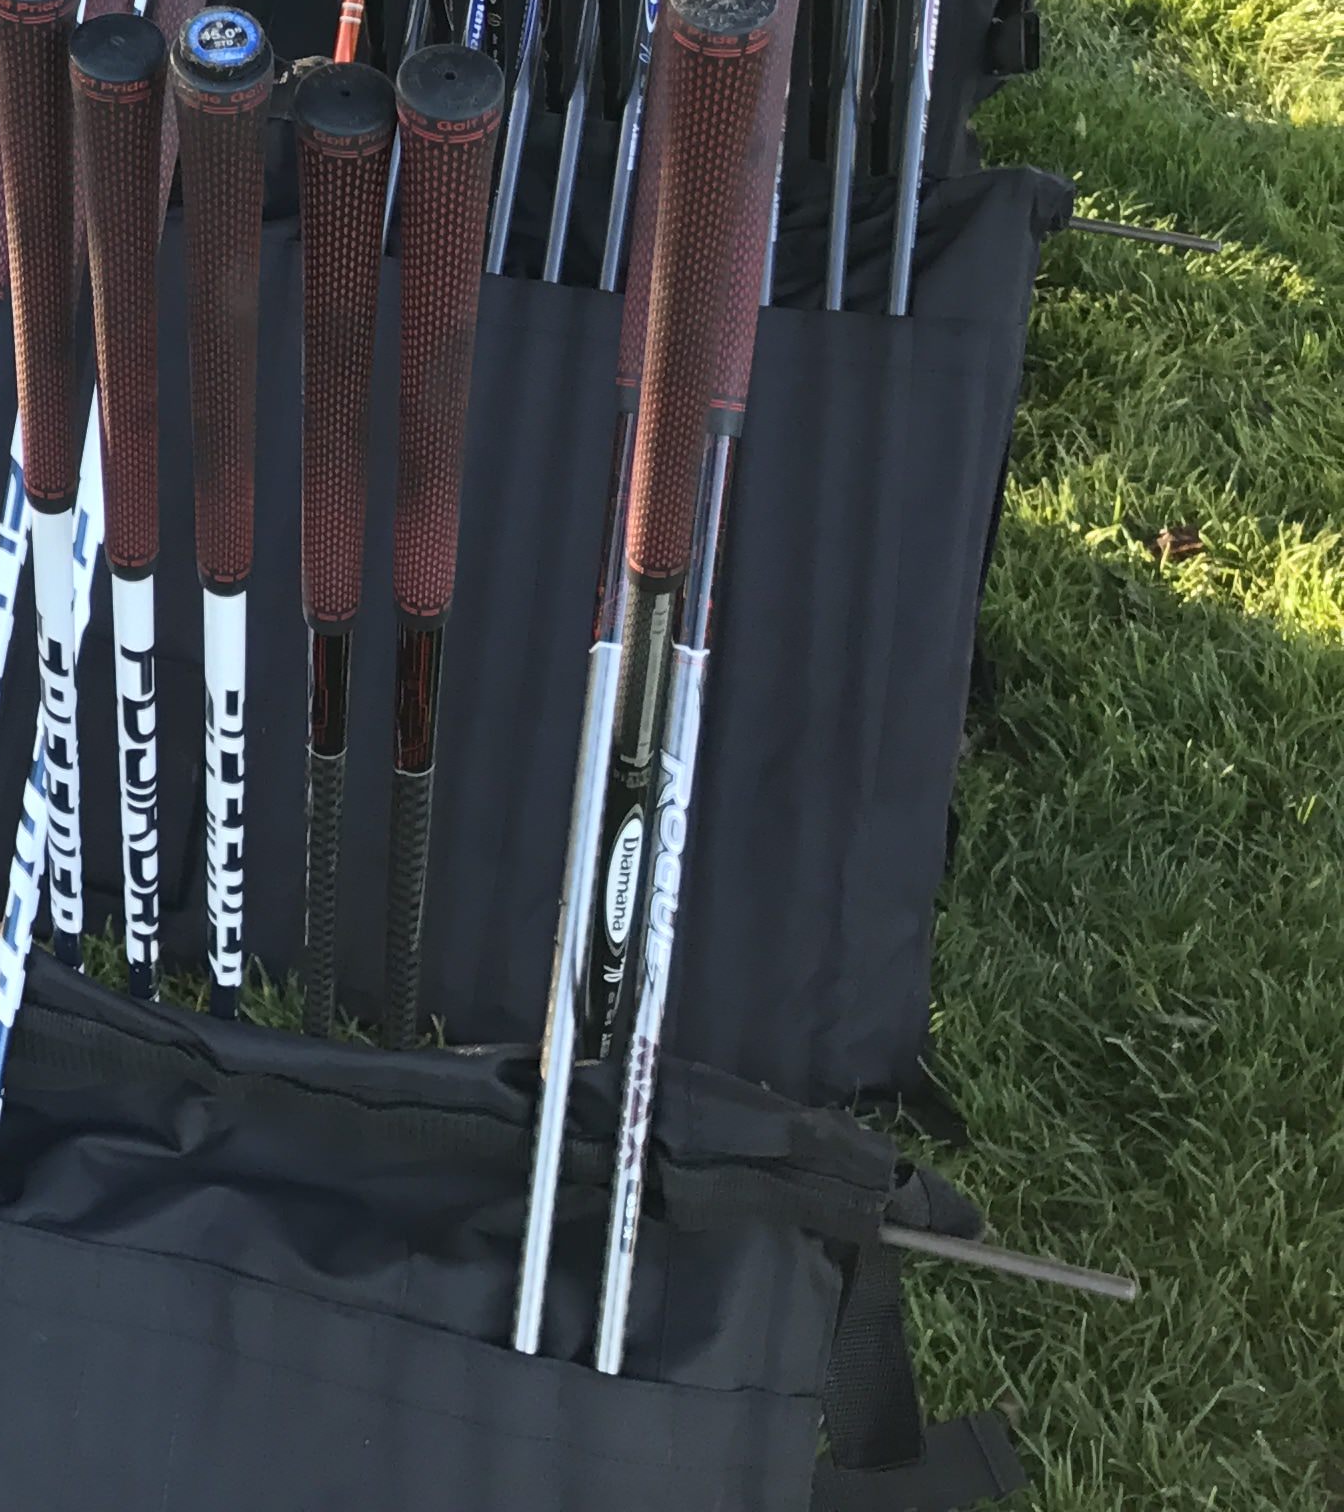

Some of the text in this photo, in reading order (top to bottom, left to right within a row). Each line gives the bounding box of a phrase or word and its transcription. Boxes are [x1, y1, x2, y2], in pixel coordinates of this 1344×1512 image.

[15, 0, 65, 13] Pride
[201, 27, 243, 41] 45.0"
[436, 119, 476, 133] Golf
[34, 614, 84, 935] SPEEDER
[612, 835, 640, 933] Diamana
[645, 748, 690, 983] ROGUE
